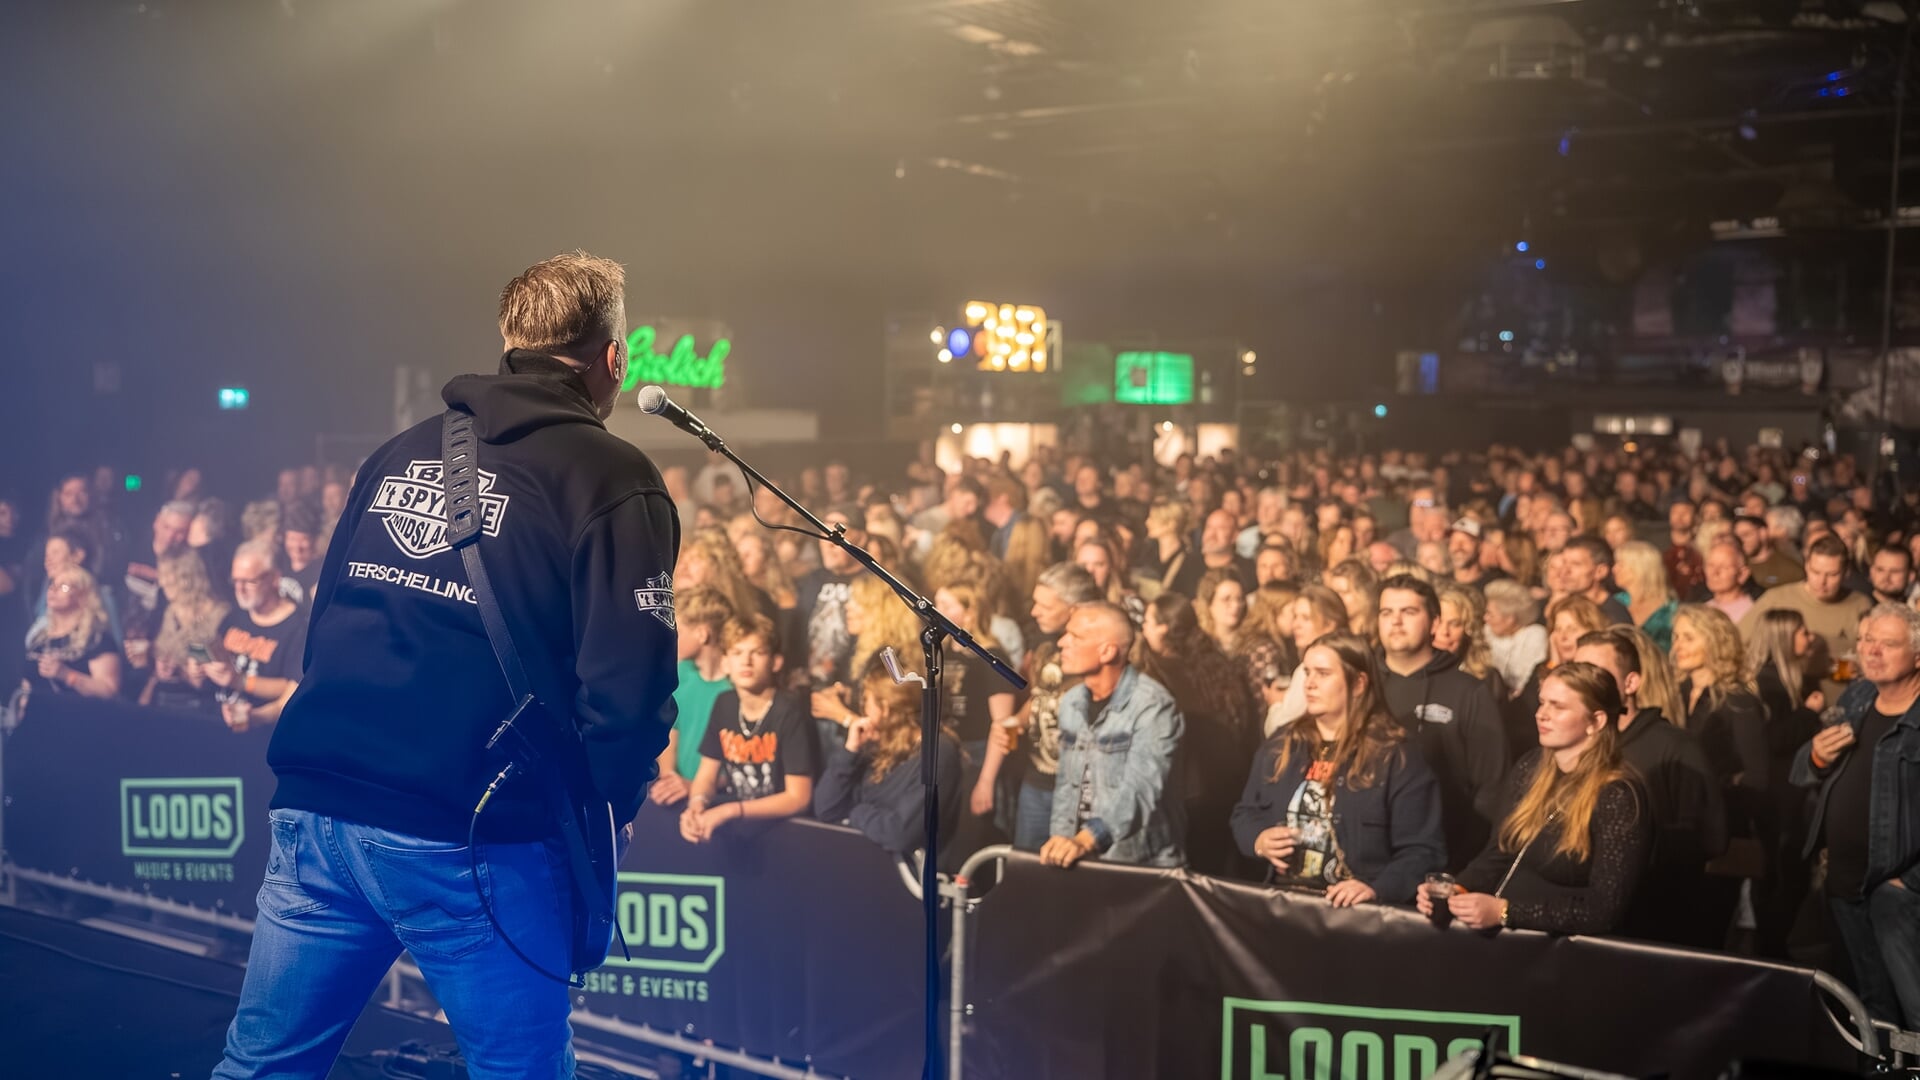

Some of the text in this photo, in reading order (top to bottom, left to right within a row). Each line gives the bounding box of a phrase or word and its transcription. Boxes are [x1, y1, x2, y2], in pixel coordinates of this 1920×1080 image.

[393, 515, 449, 551] MIDSLAN
[348, 561, 478, 604] TERSCHELLING
[132, 794, 233, 840] LOODS
[617, 892, 709, 951] ODS
[582, 971, 709, 1002] SIC & EVENTS
